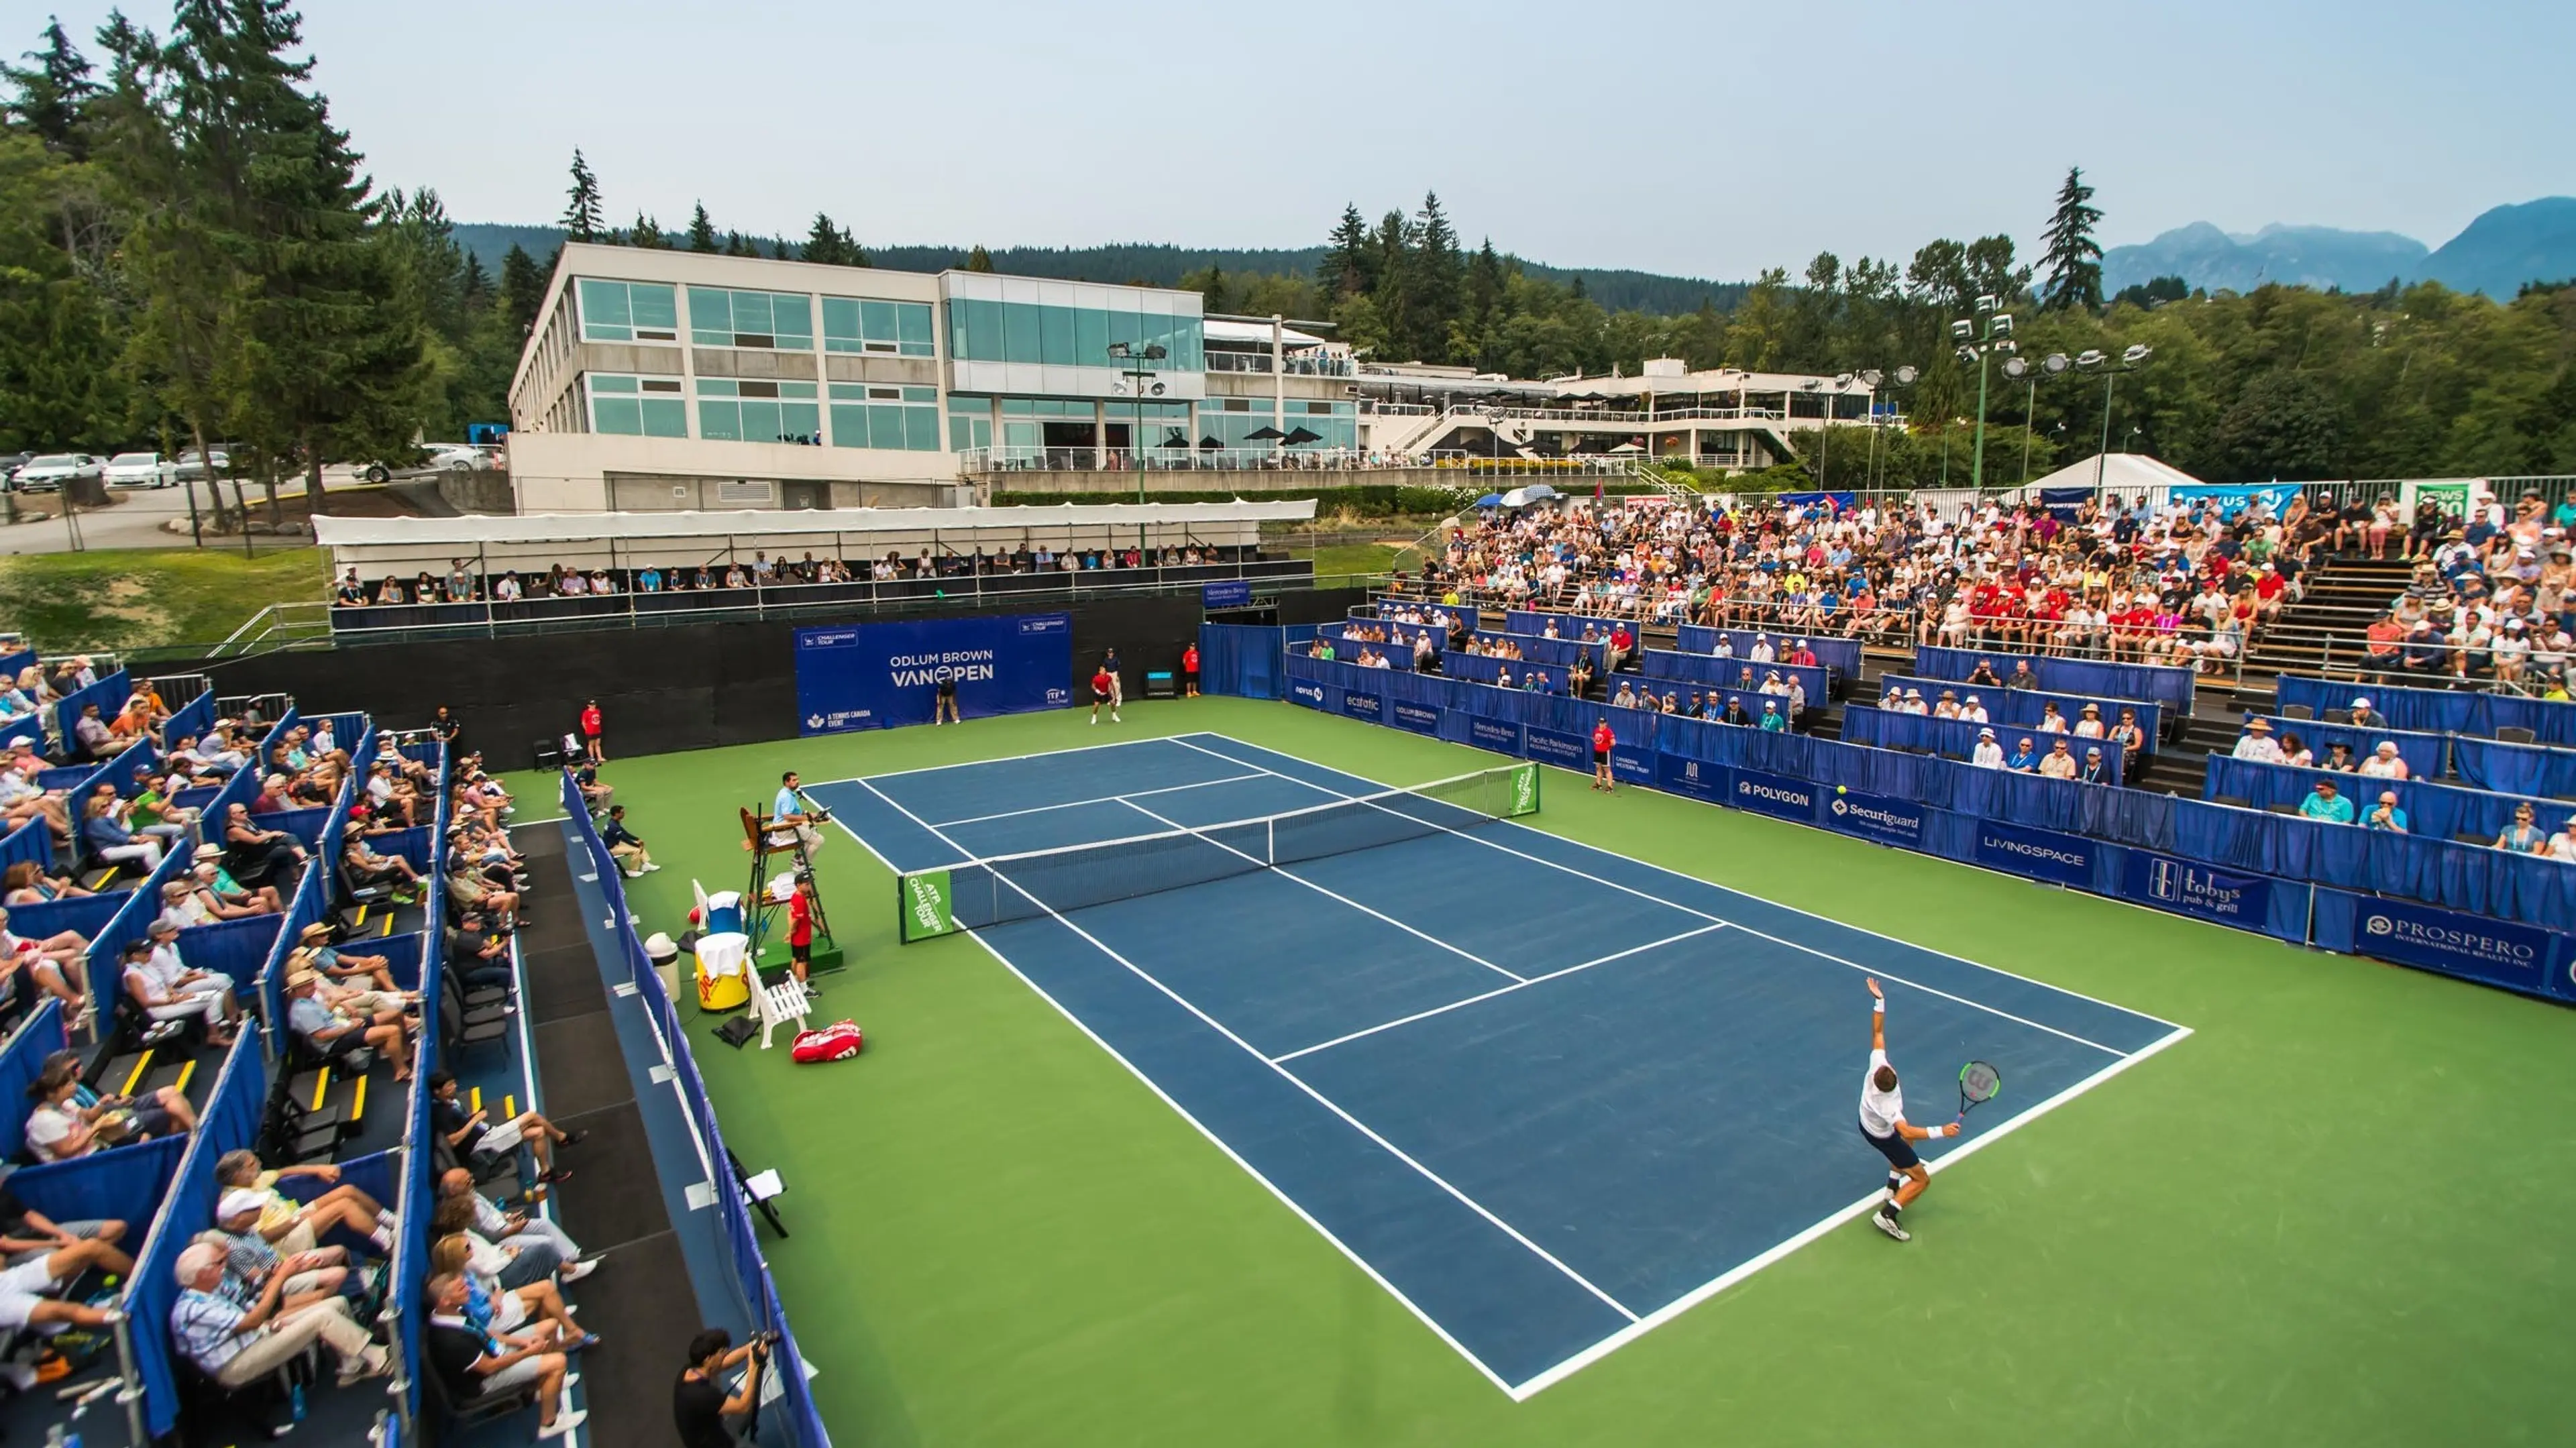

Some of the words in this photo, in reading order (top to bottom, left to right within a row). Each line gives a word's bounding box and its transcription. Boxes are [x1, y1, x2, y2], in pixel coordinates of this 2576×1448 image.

[890, 653, 938, 667] ODLUM
[943, 649, 993, 663] BROWN
[850, 710, 871, 718] CANADA
[1347, 696, 1379, 711] ecstatic
[828, 719, 844, 727] EVENT
[1754, 785, 1809, 807] POLYGON
[1849, 803, 1919, 829] Securiguard
[1984, 836, 2085, 866] LIVINGSPACE
[926, 883, 941, 904] ATP
[2183, 895, 2203, 905] pub
[2205, 899, 2214, 907] &
[2216, 902, 2238, 913] grill
[910, 878, 943, 932] CHALLENGER
[914, 903, 932, 928] TOUR
[2394, 933, 2470, 954] INTERNATIONAL
[2396, 920, 2534, 958] PROSPERO
